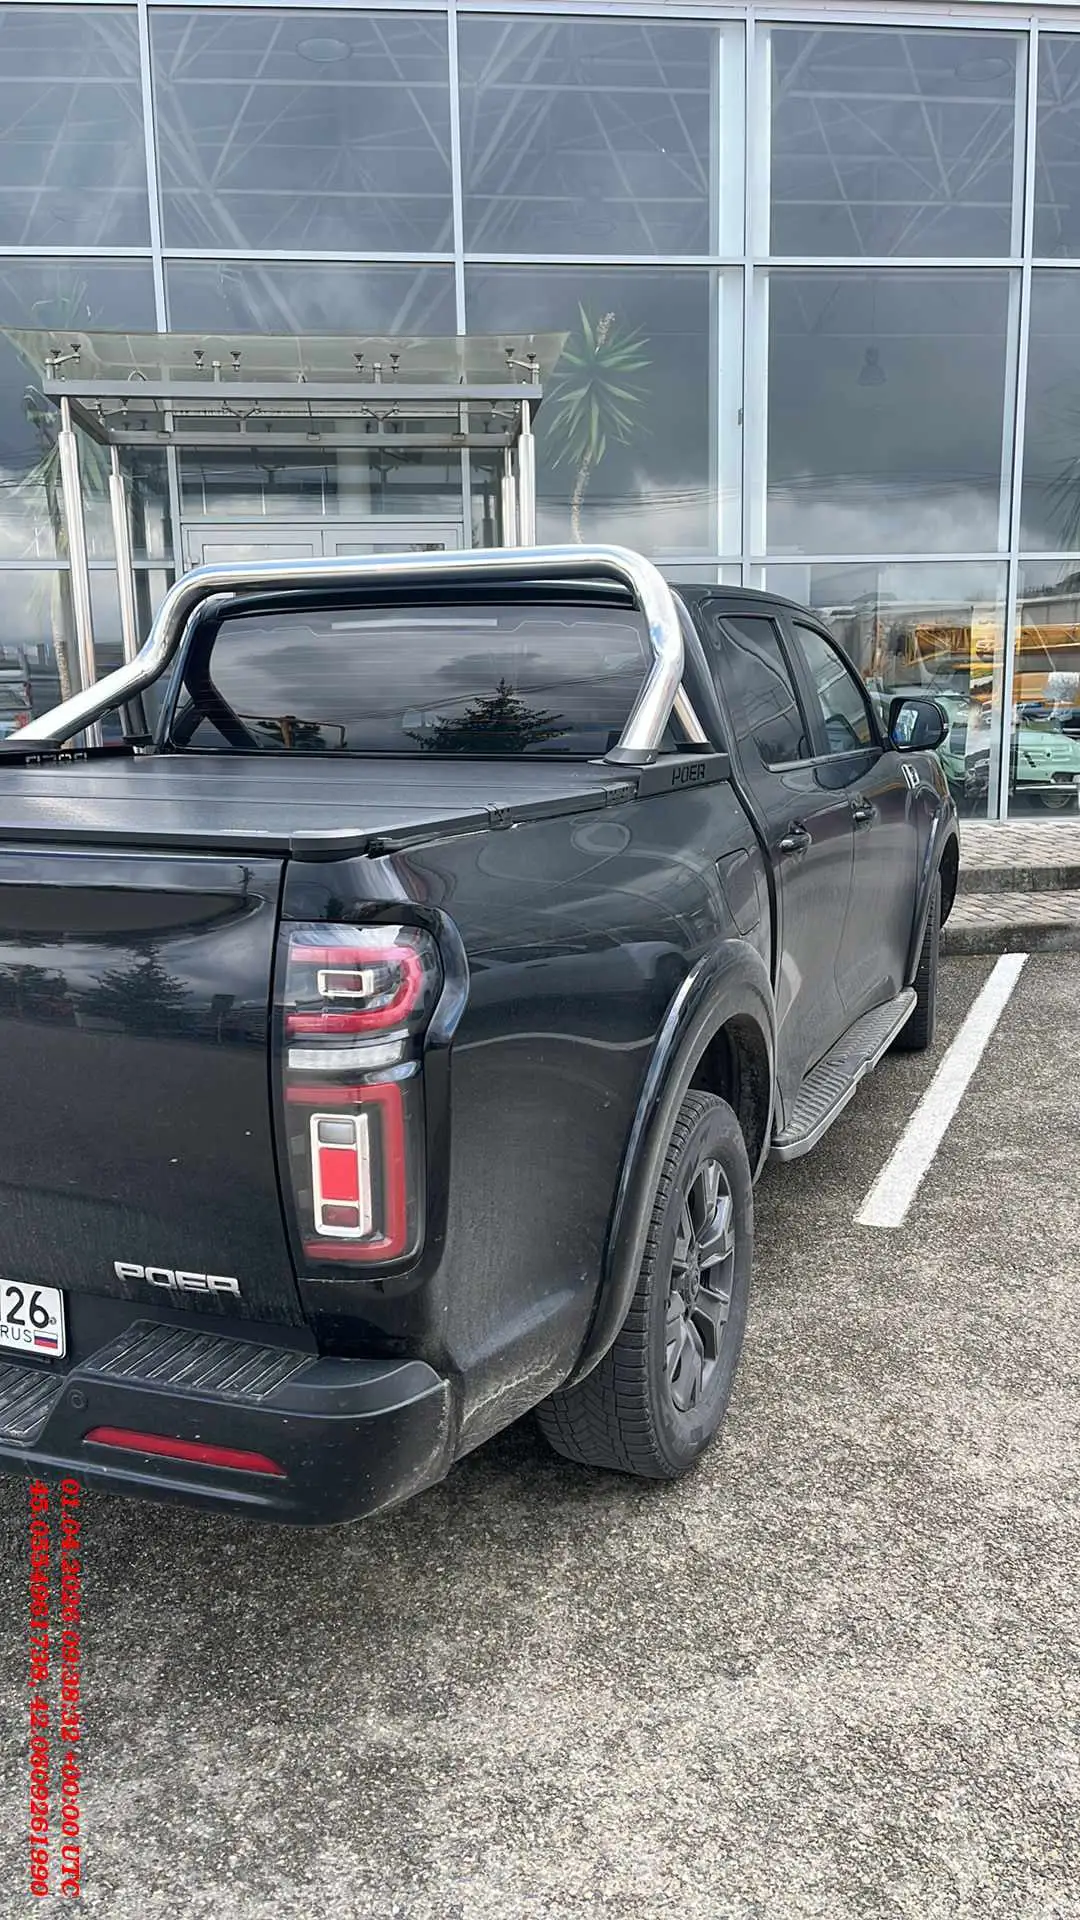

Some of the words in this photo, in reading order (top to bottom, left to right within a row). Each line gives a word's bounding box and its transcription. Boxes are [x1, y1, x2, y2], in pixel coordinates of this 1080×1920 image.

[672, 764, 705, 786] POER
[114, 1261, 241, 1297] POER
[0, 1286, 49, 1328] 26
[0, 1325, 32, 1342] RUS
